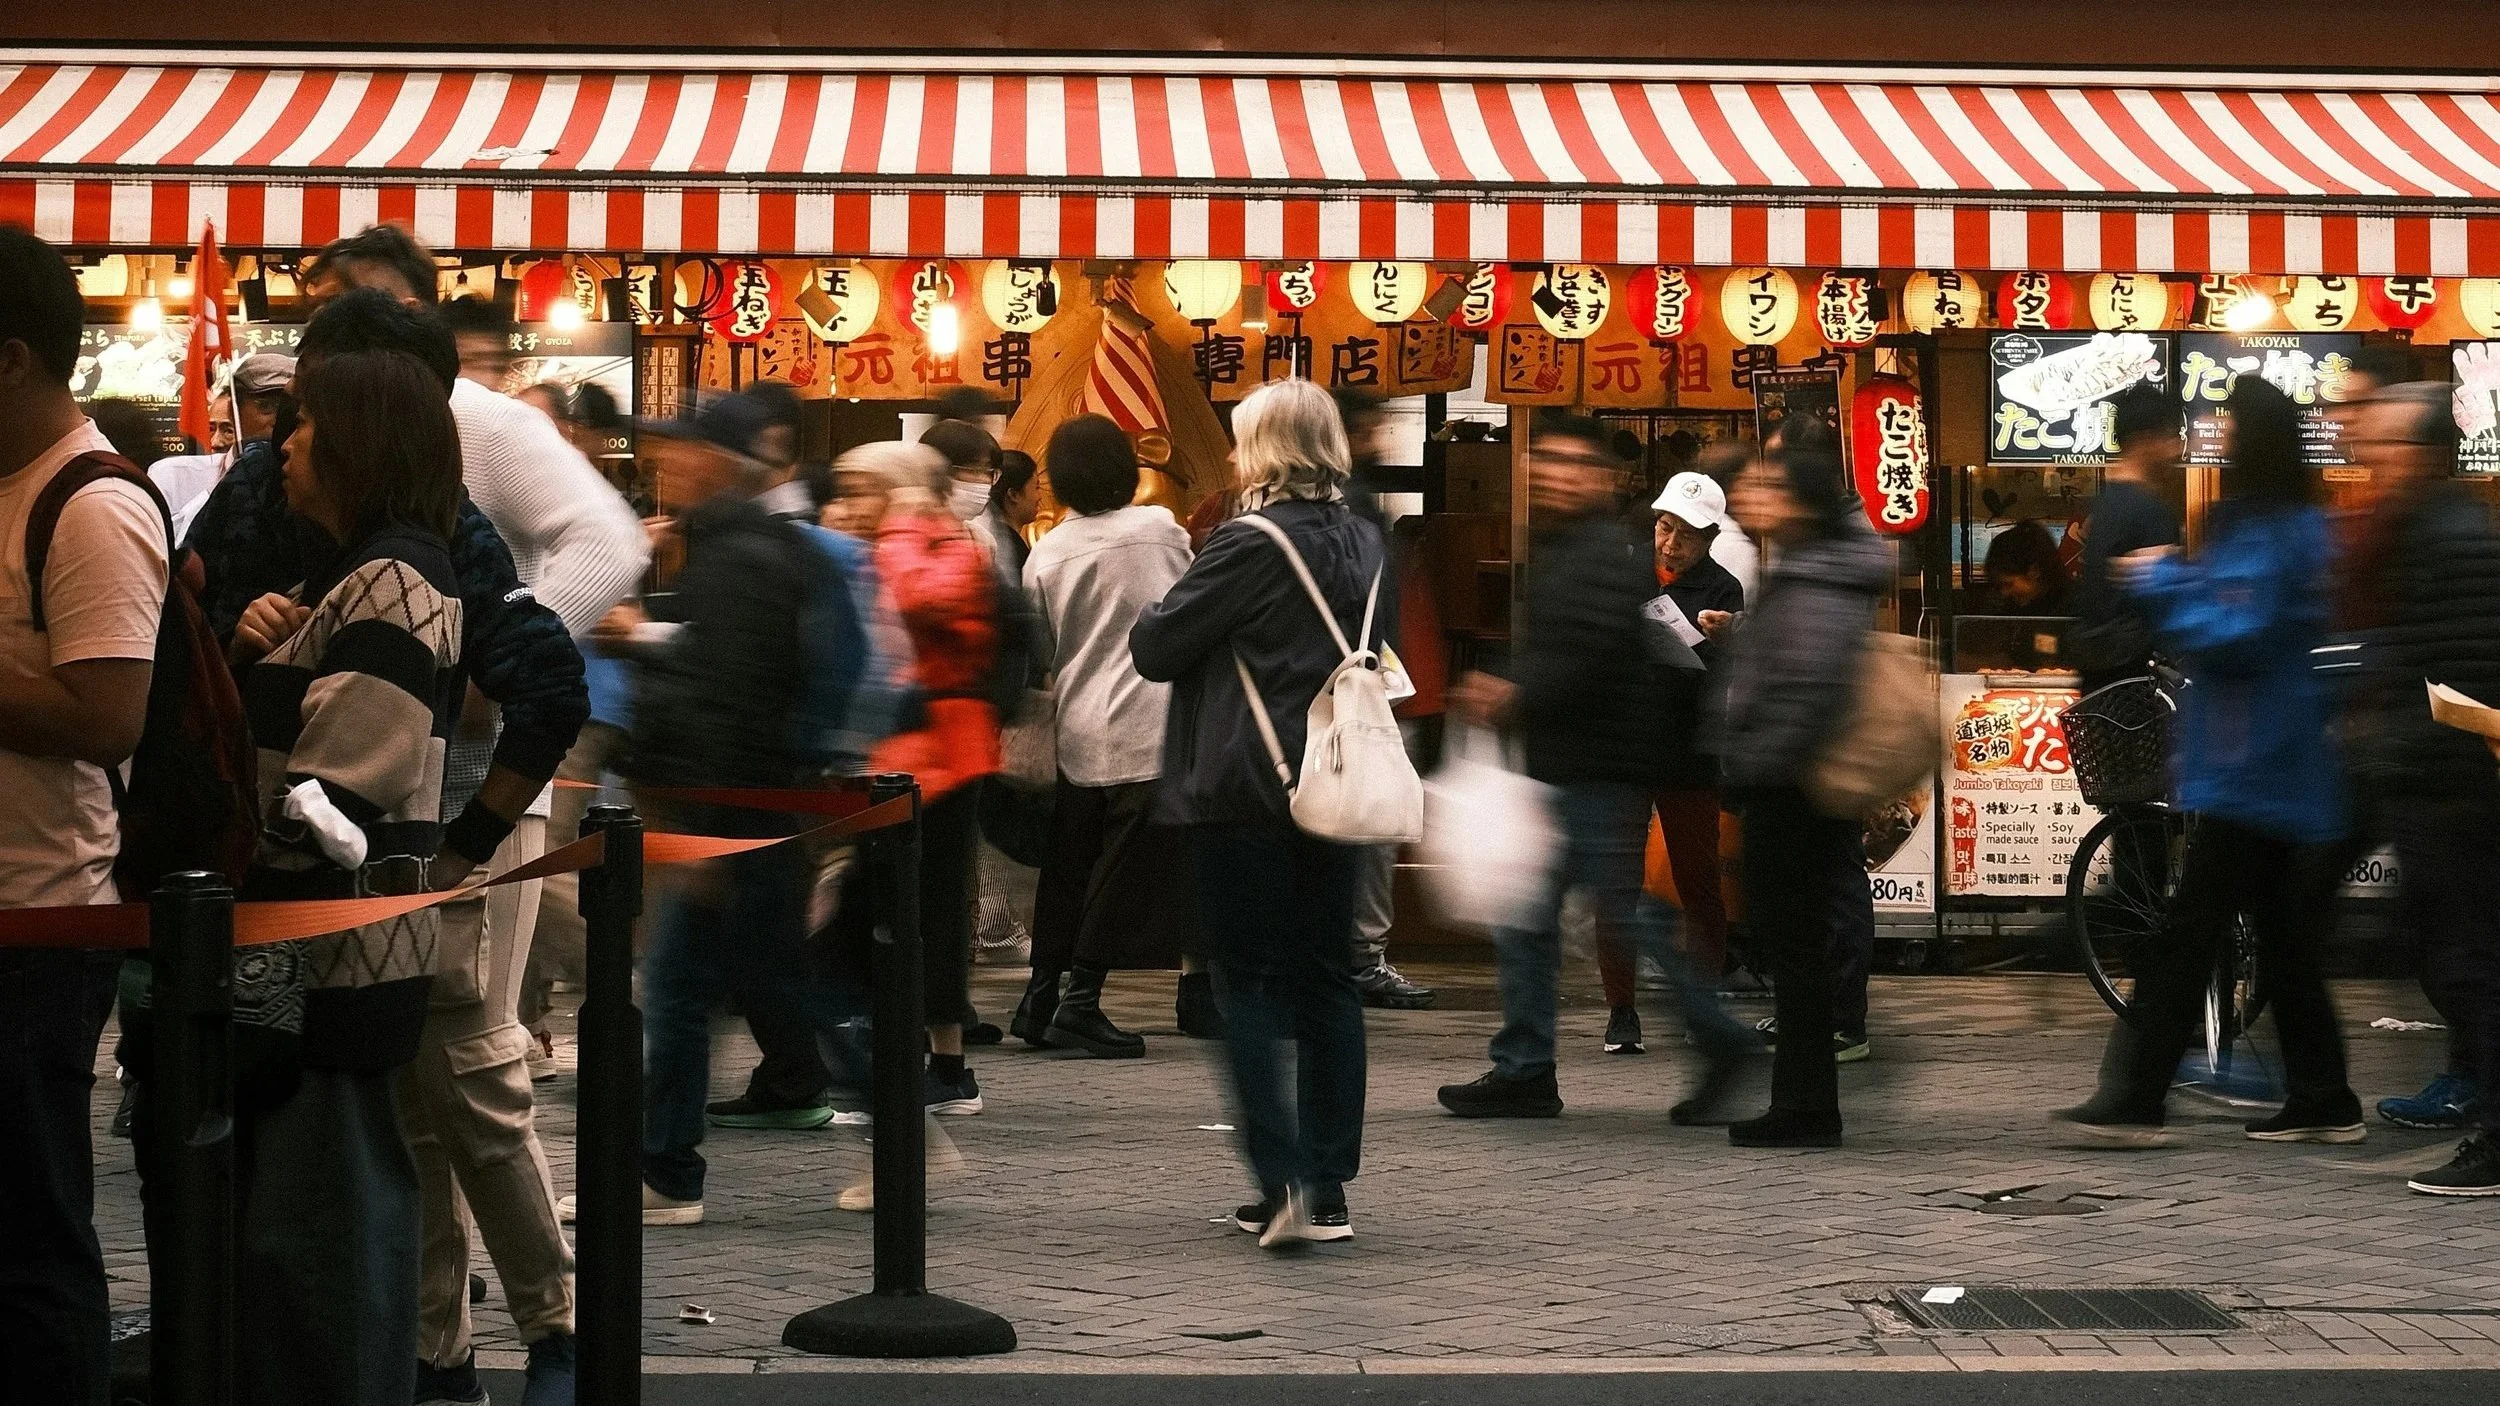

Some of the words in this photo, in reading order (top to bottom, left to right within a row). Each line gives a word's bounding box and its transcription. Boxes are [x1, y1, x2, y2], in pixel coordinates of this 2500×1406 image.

[1006, 267, 1036, 325] しょうが
[1749, 271, 1777, 338] イワシ
[1821, 273, 1850, 340] 本揚げ
[2239, 336, 2300, 348] TAKOYAKI
[2459, 437, 2500, 454] 神戸牛
[1881, 401, 1916, 520] たこ焼き
[2053, 455, 2105, 464] TAKOYAKI
[1956, 713, 2014, 741] 道頓堀
[1969, 739, 2011, 763] 名物
[1953, 777, 1992, 791] Jumbo
[1993, 777, 2044, 793] Takoyaki
[1949, 823, 1978, 839] Taste
[1985, 821, 2036, 835] Specially
[2051, 821, 2074, 835] Soy
[1986, 834, 2012, 845] made
[2013, 835, 2039, 845] sauce
[2010, 853, 2031, 865] 소스
[1950, 871, 1978, 886] 口味
